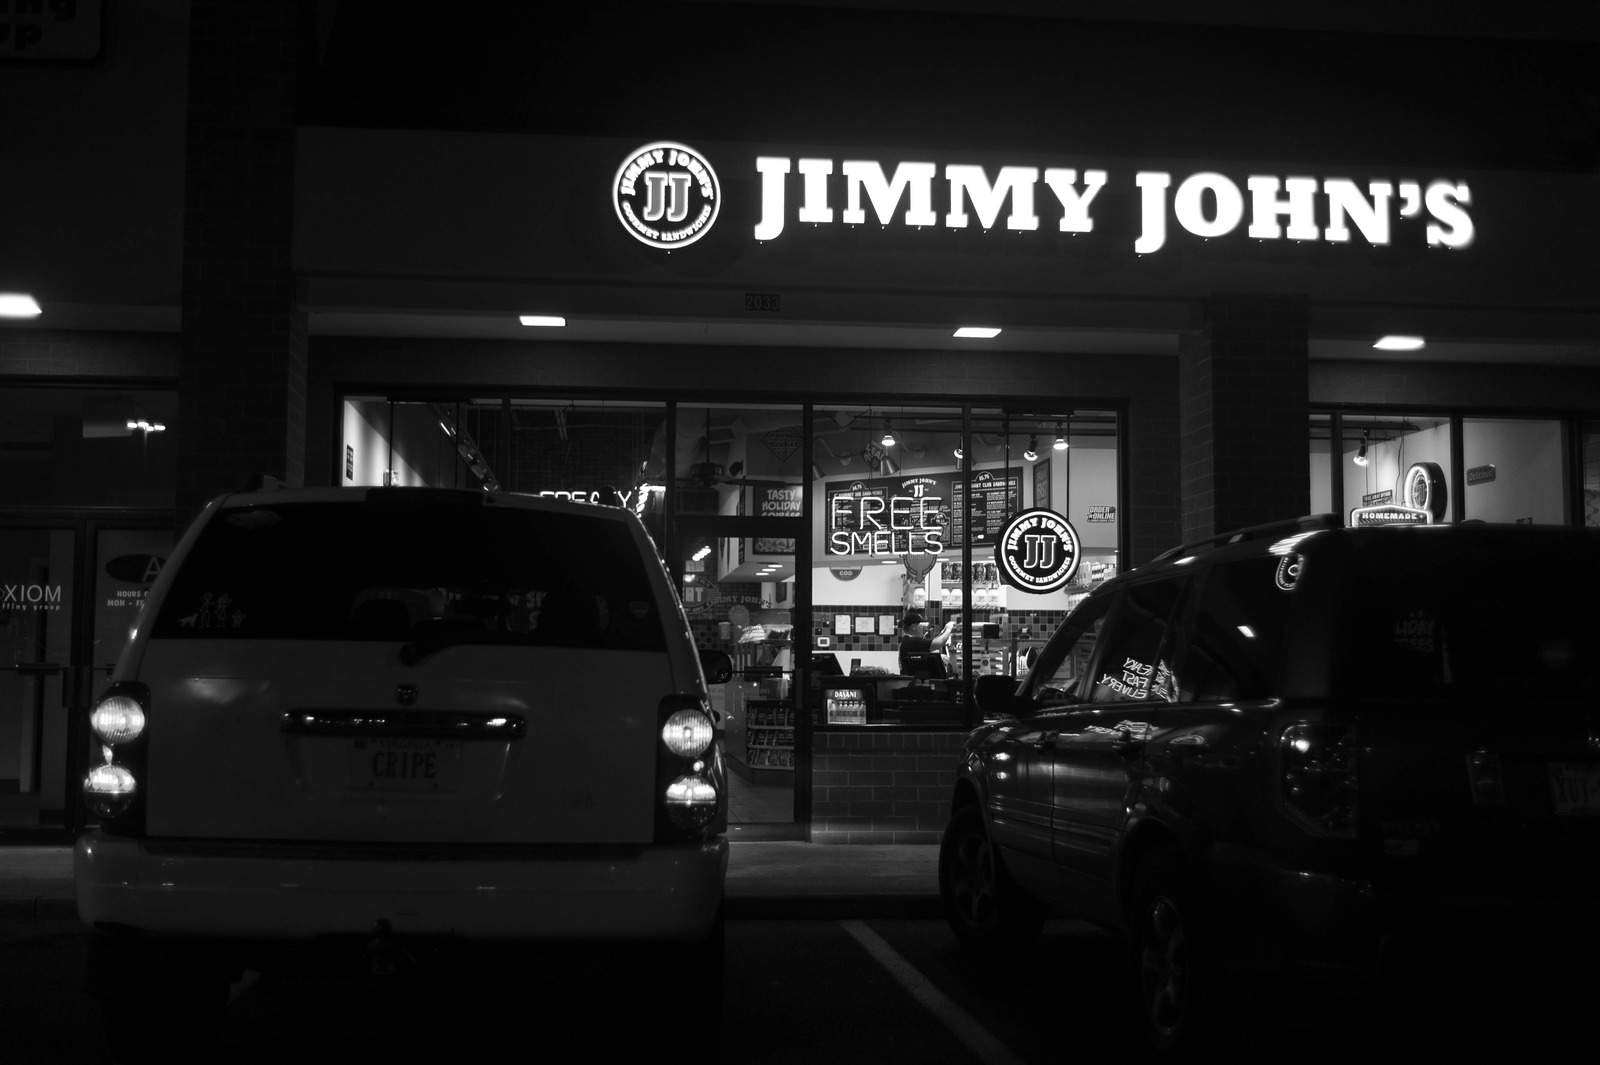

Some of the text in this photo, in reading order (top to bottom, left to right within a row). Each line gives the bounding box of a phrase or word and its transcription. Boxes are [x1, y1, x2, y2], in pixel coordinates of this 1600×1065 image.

[621, 149, 714, 200] JIMMY JOHN'S
[643, 171, 692, 222] JJ
[755, 156, 1474, 253] JIMMY JOHN'S
[746, 295, 779, 310] 2033
[762, 501, 801, 511] HOLIDAY
[767, 489, 796, 501] TASTY
[832, 497, 942, 530] FREE
[1089, 506, 1110, 514] ORDER
[1093, 512, 1115, 520] ONLINE
[1362, 512, 1418, 520] HOMEMADE
[830, 531, 943, 555] SMELLS
[1007, 517, 1038, 551] JIMMY
[1040, 517, 1073, 553] JOHN'S
[1024, 535, 1056, 568] JJ
[117, 590, 141, 598] HOURS
[373, 751, 437, 778] CRIPE
